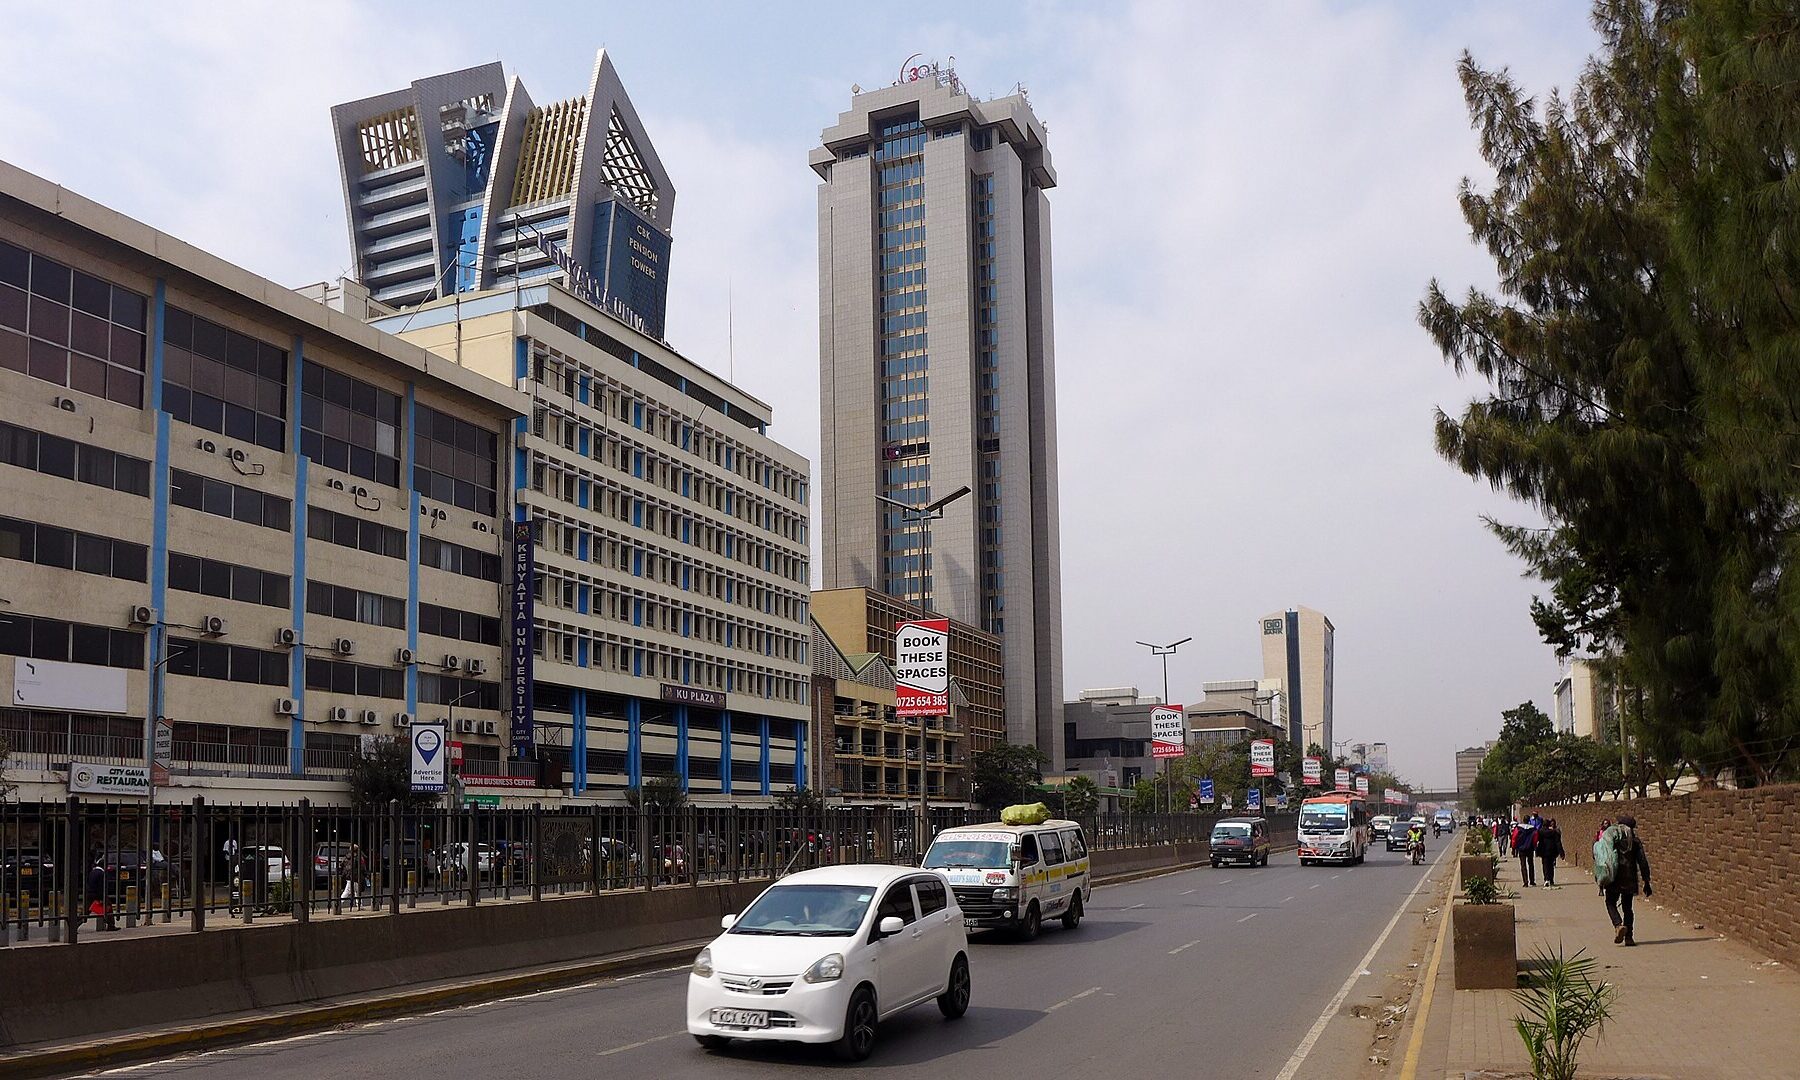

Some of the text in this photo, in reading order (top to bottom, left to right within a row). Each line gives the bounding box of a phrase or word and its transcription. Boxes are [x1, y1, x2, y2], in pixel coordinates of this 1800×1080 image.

[636, 225, 651, 240] CBK
[629, 237, 658, 264] PENSION
[631, 256, 656, 279] TOWERS
[516, 543, 527, 724] KENYATTA UNIVERSITY
[903, 636, 941, 648] BOOK
[900, 652, 943, 663] THESE
[897, 667, 946, 679] SPACES
[676, 689, 715, 704] KU PLAZA
[896, 695, 947, 707] 0725 654 385
[1155, 713, 1178, 721] BOOK
[1152, 730, 1183, 738] SPACES
[125, 769, 145, 777] GAVA
[97, 776, 150, 786] RESTAURAN
[484, 778, 513, 786] BUSINESS
[514, 779, 536, 787] CENTRE
